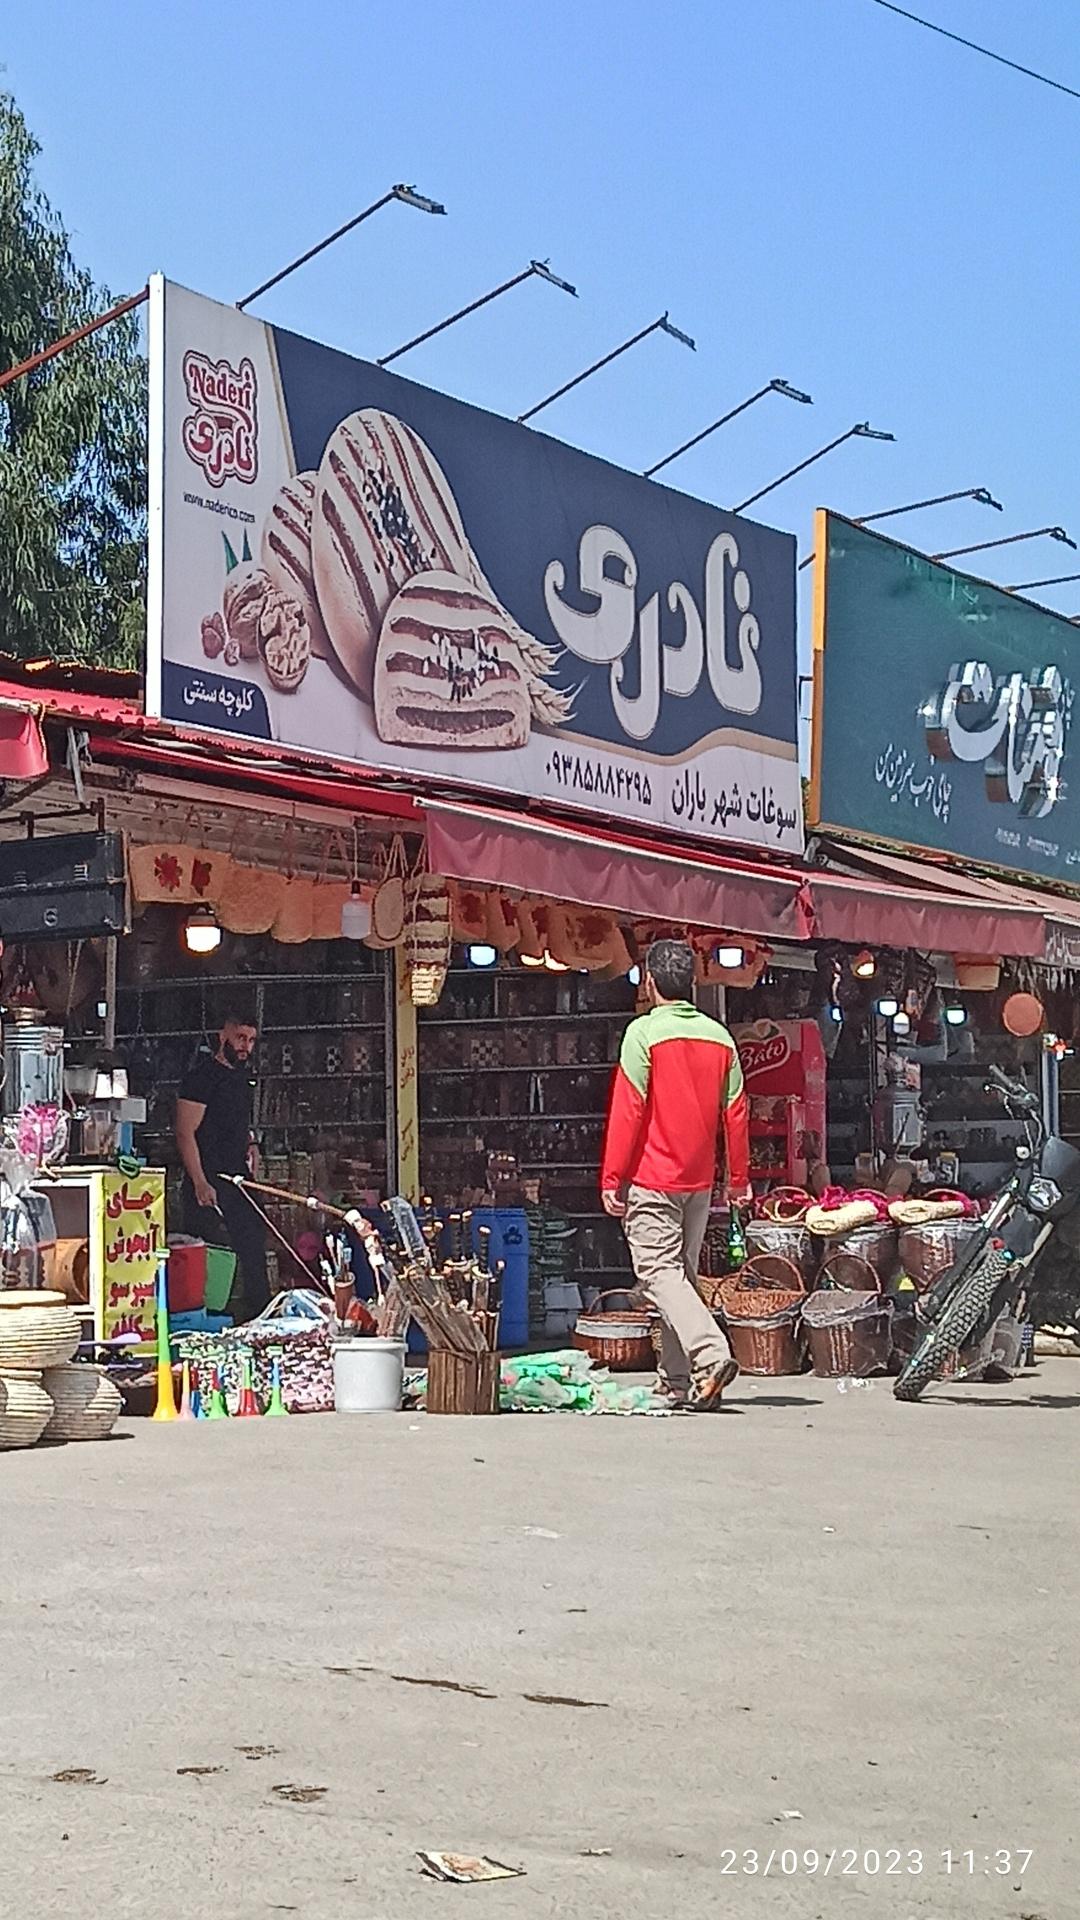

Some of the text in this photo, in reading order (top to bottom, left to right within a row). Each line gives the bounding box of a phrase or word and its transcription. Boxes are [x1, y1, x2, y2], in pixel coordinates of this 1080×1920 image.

[188, 363, 253, 412] Naderi
[188, 420, 253, 475] نادری
[544, 523, 762, 741] نادری
[183, 680, 255, 717] کلوچه سنتی
[671, 768, 797, 838] سوغات شهر باران
[107, 1182, 155, 1219] چای
[107, 1223, 160, 1263] آبجوش
